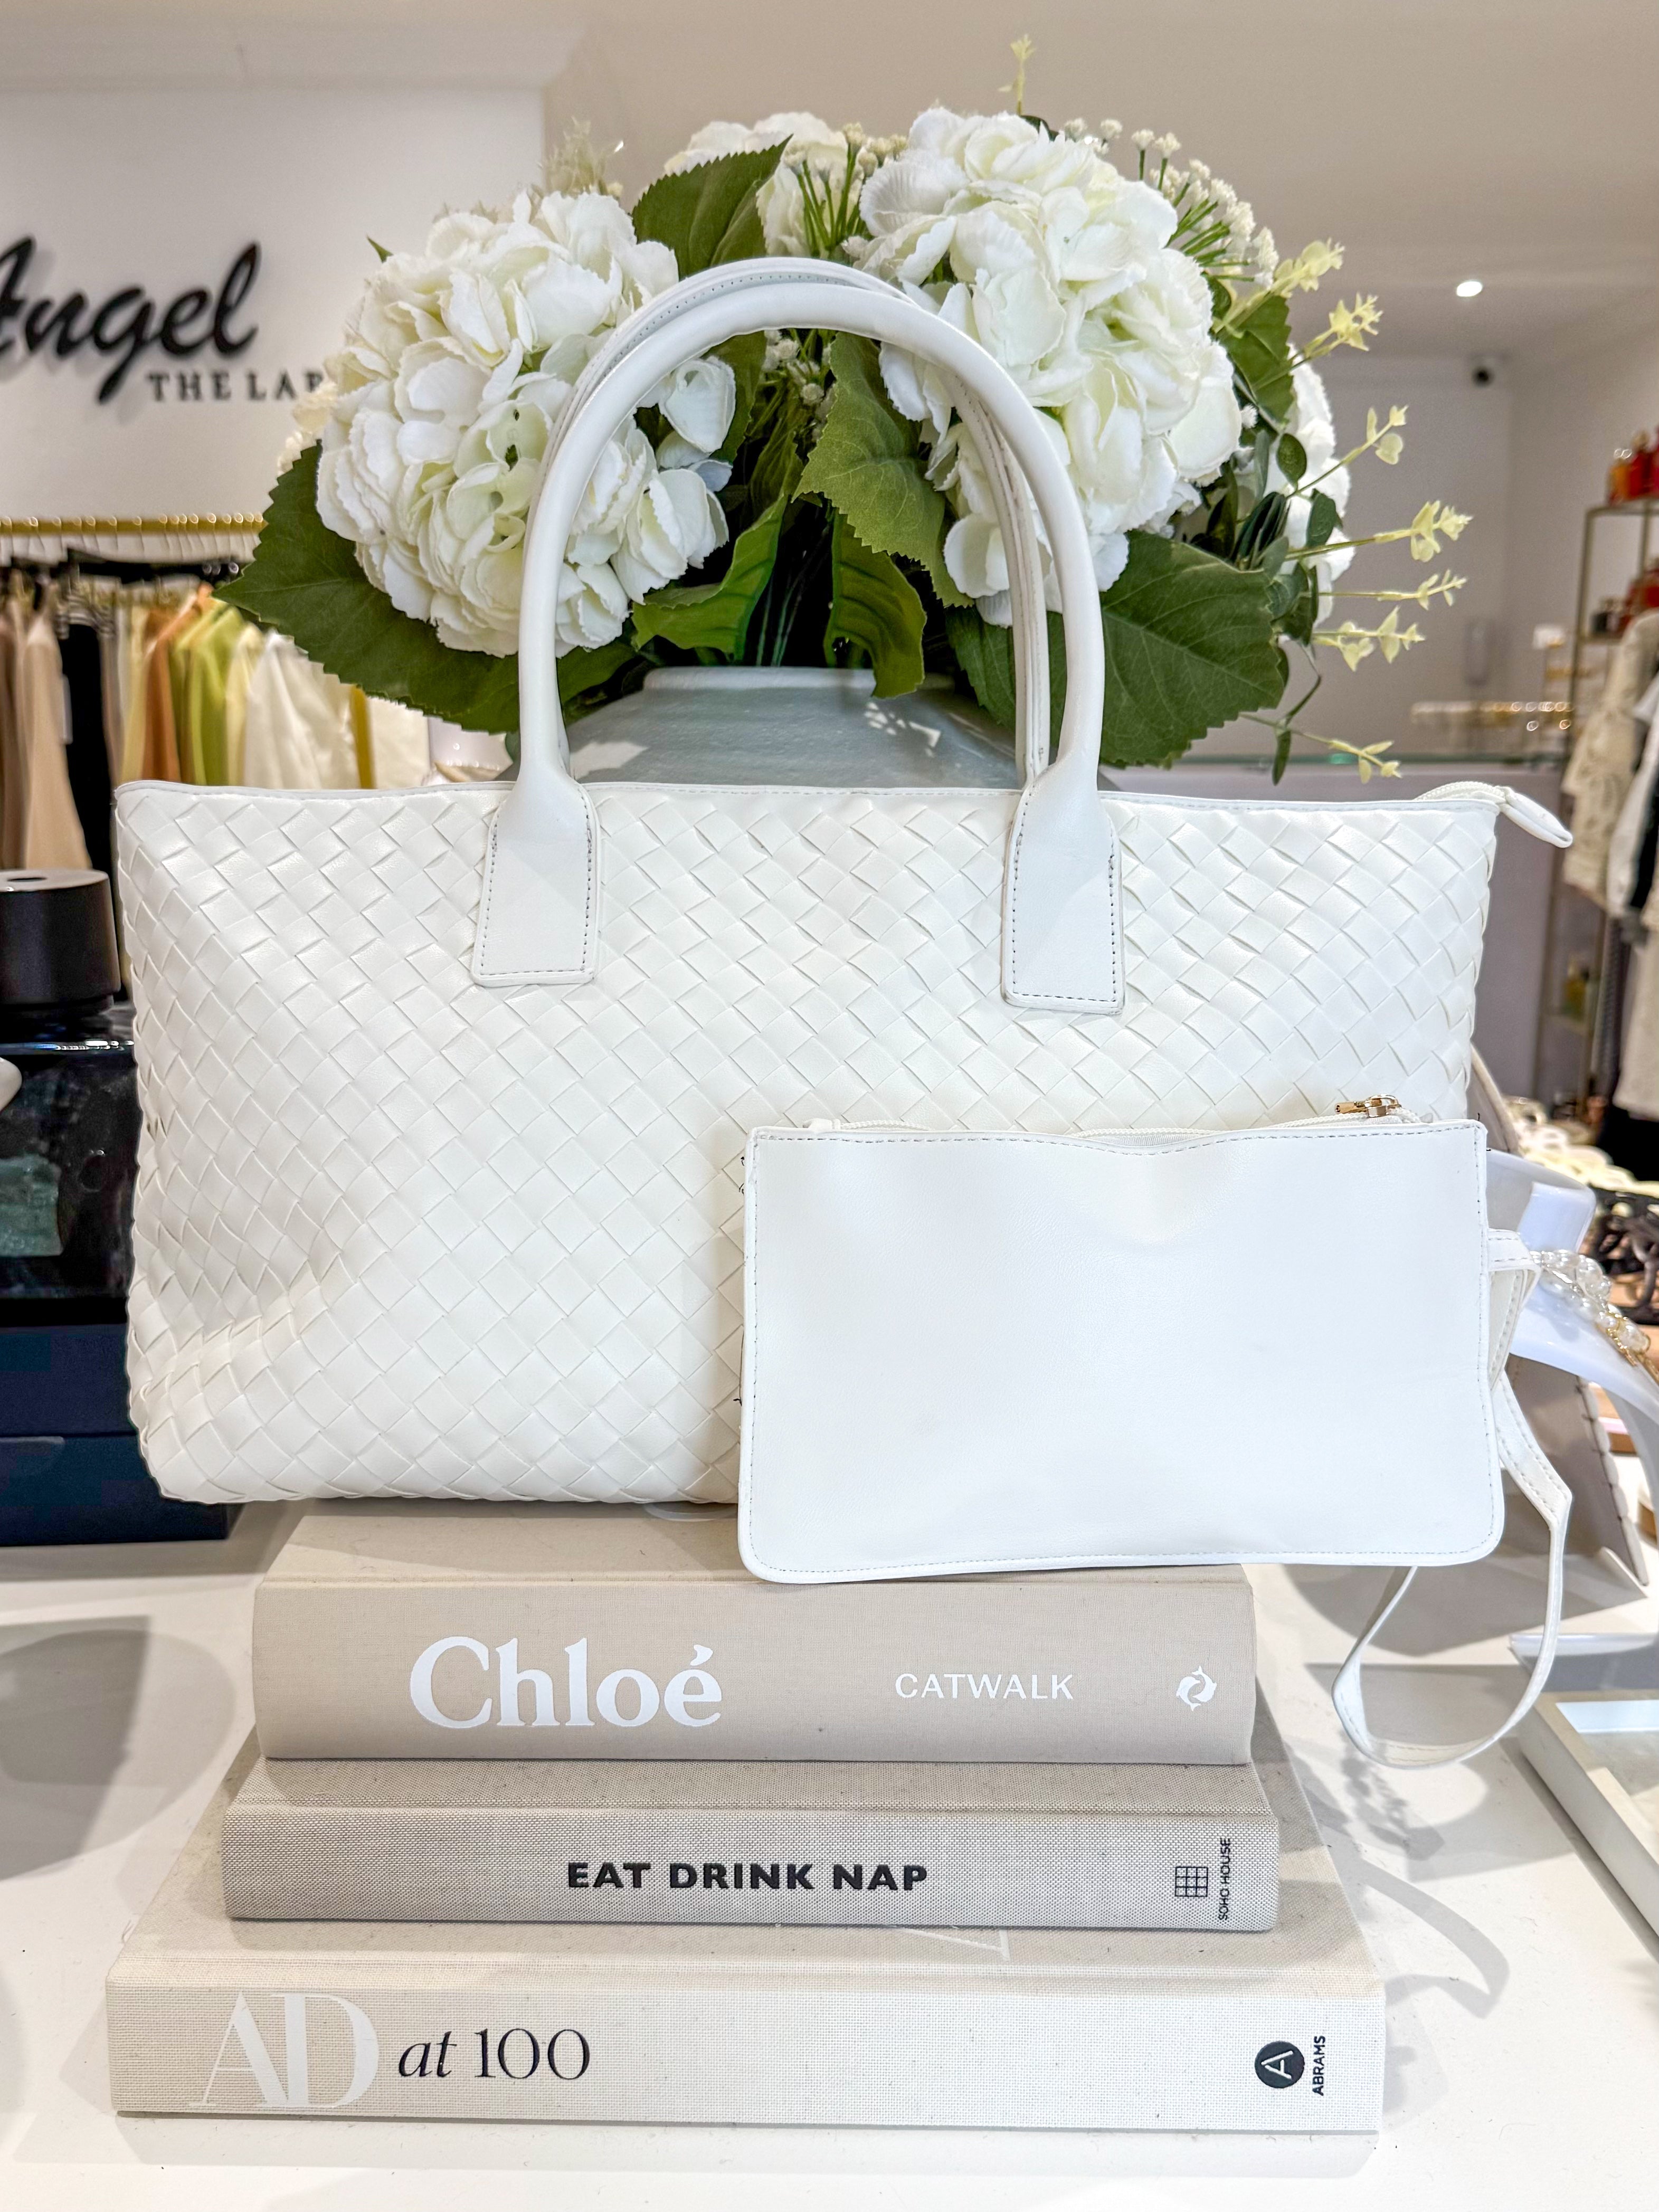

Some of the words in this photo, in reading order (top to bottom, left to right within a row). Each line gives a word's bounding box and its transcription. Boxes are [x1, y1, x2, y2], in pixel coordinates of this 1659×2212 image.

[148, 372, 231, 401] THE
[410, 1636, 722, 1728] Chloé
[895, 1673, 1074, 1700] CATWALK
[567, 1862, 651, 1889] EAT
[669, 1863, 815, 1890] DRINK
[832, 1864, 928, 1891] NAP
[1220, 1838, 1230, 1884] HOUSE
[1218, 1888, 1230, 1921] SOHO
[189, 1990, 379, 2109] AD
[399, 2030, 457, 2078] at
[474, 2028, 590, 2080] 100
[1312, 2035, 1325, 2096] ABRAMS
